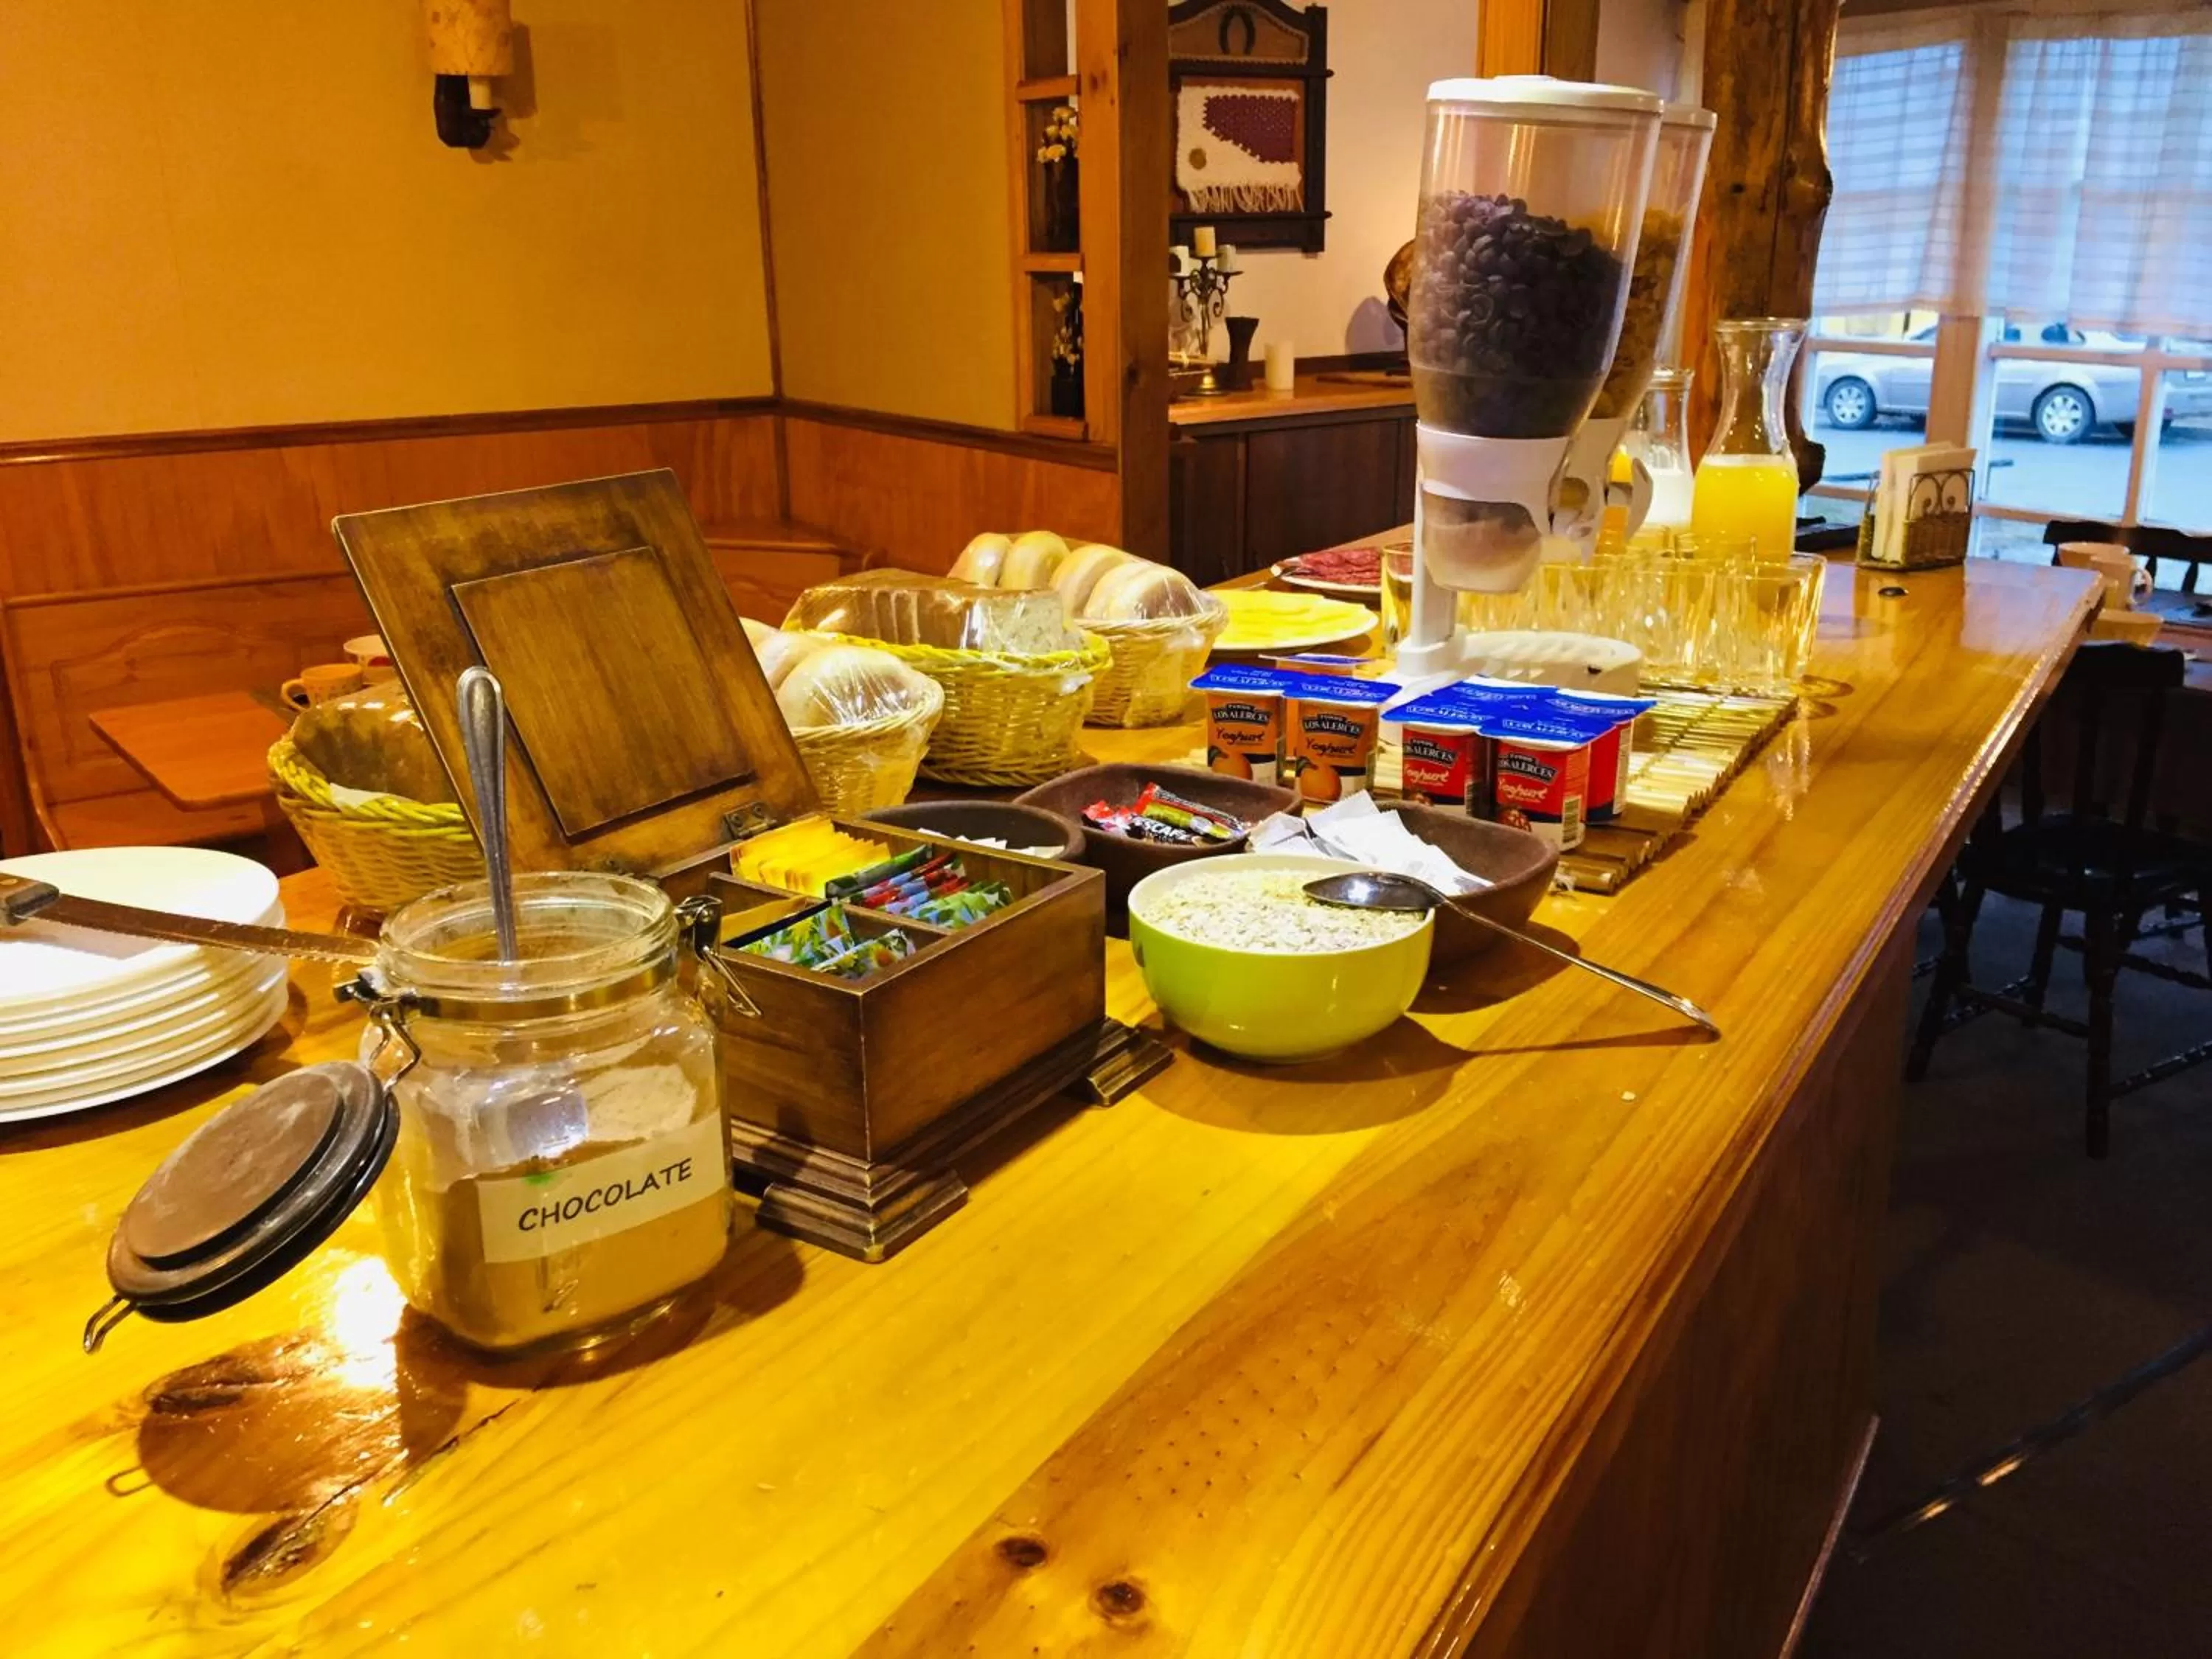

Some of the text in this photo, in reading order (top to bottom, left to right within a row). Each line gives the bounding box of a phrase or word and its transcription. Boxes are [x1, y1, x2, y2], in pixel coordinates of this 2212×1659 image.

[1216, 727, 1265, 745] Yoghurt
[1306, 737, 1358, 756] Yoghurt
[518, 1157, 693, 1231] CHOCOLATE
